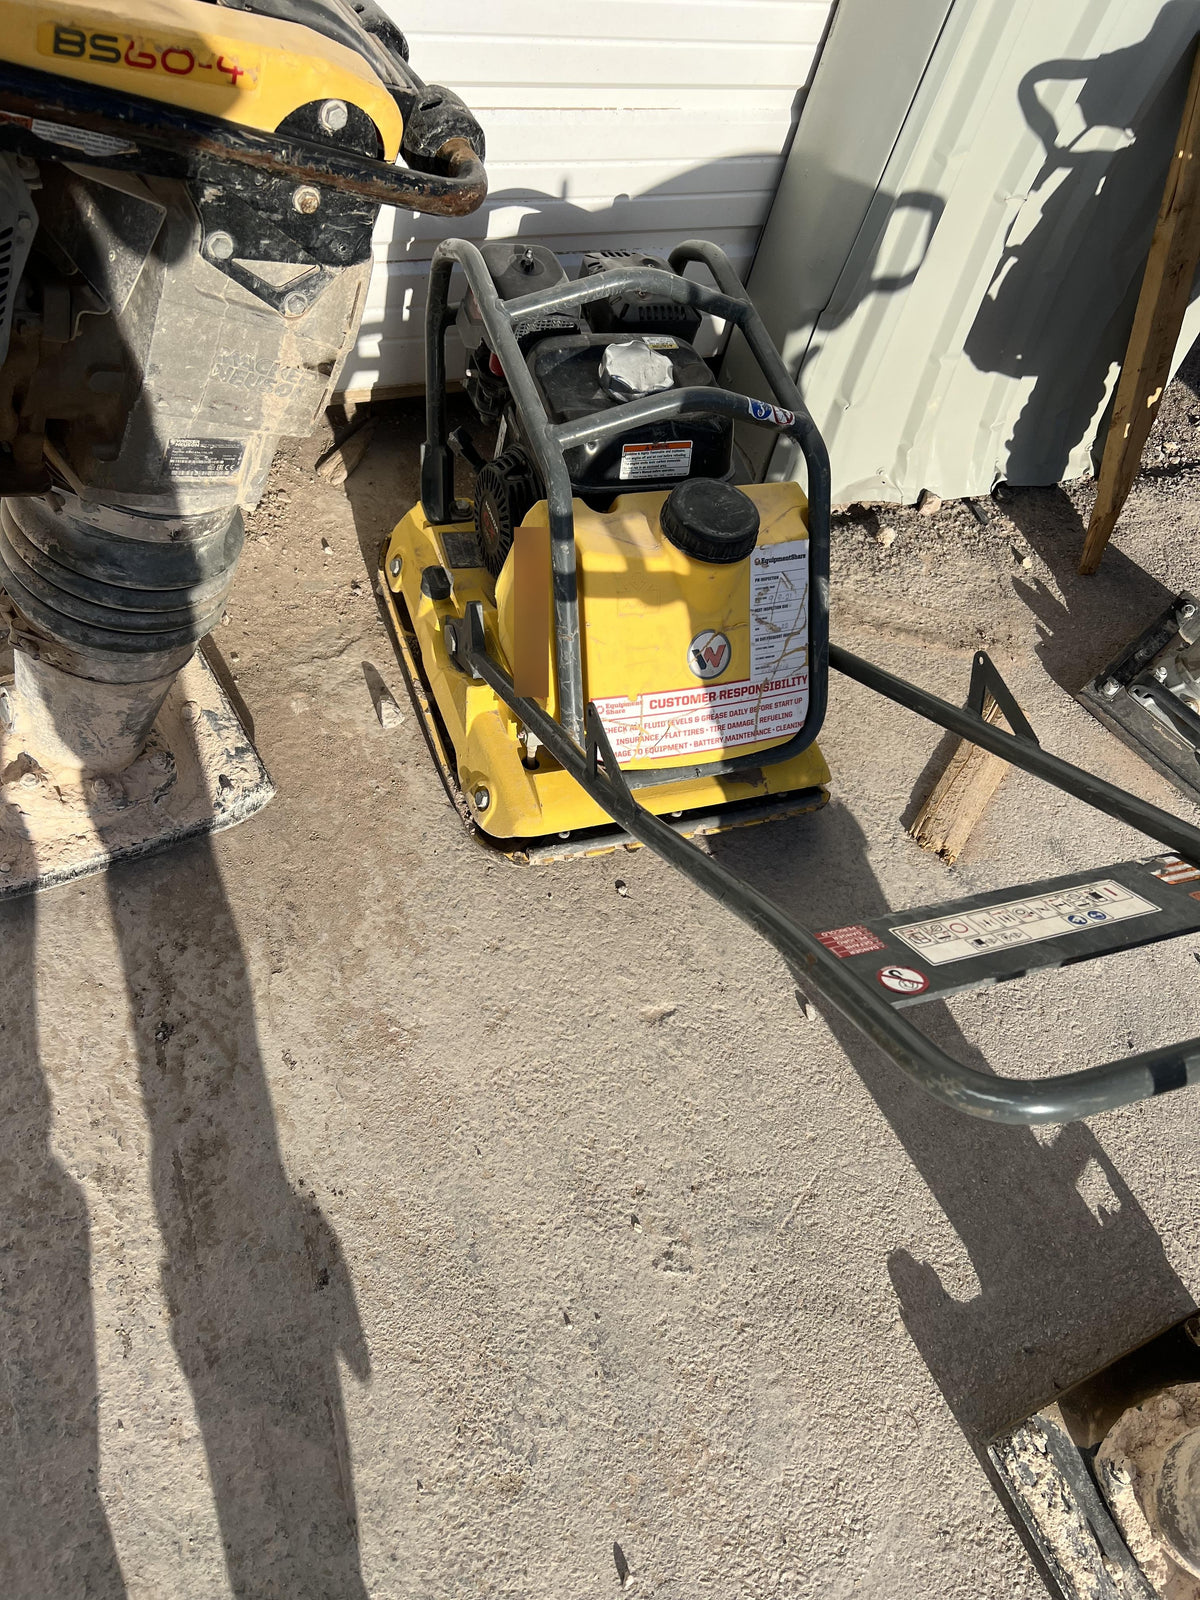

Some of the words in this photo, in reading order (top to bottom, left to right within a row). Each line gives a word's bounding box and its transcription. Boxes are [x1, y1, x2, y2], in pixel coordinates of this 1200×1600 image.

[53, 25, 244, 86] BS60-4
[761, 553, 806, 565] EquipmentShare
[605, 700, 643, 709] Equipment
[649, 691, 717, 710] CUSTOMER
[719, 675, 808, 701] RESPONSIBILITY
[605, 708, 626, 716] Share
[644, 720, 666, 730] FLUID
[668, 716, 693, 727] EVELS
[701, 712, 728, 722] GREASE
[729, 708, 748, 718] DAILY
[774, 698, 793, 709] START
[794, 697, 803, 705] UP
[614, 749, 631, 758] MAGE
[645, 742, 688, 755] EQUIPMENT
[694, 736, 724, 748] BATTERY
[725, 728, 772, 743] MAINTENANCE
[616, 734, 659, 746] INSURANCE
[665, 731, 681, 739] FLAT
[683, 727, 705, 737] TIRES
[710, 723, 726, 733] TIRE
[728, 719, 755, 730] DAMAGE
[760, 711, 793, 724] REFUELING
